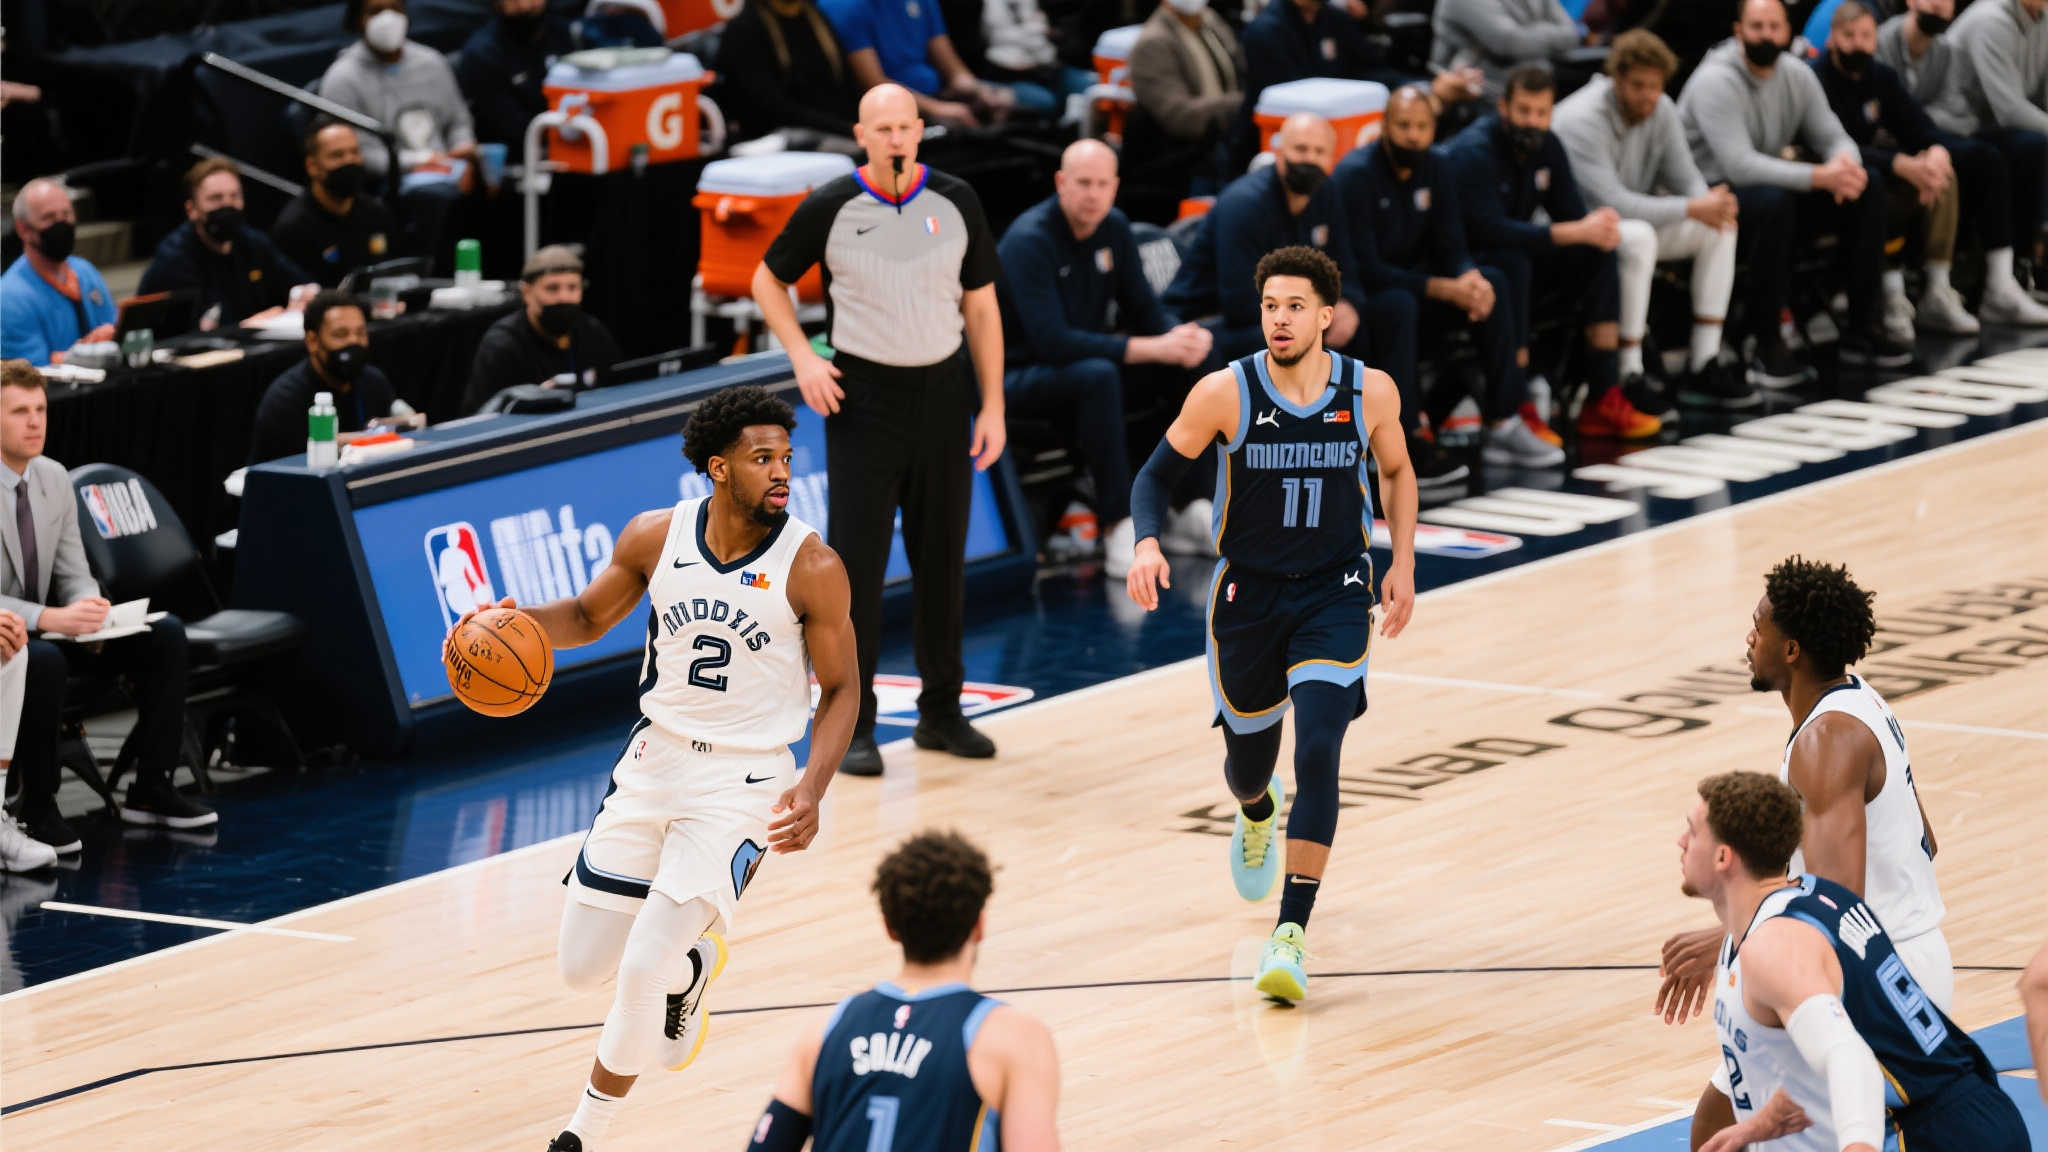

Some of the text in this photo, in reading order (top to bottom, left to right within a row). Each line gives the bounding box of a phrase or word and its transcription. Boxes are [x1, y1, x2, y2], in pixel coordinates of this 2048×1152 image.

[646, 92, 684, 150] G
[1281, 477, 1324, 528] 11
[688, 634, 732, 692] 2
[865, 1095, 900, 1152] 1
